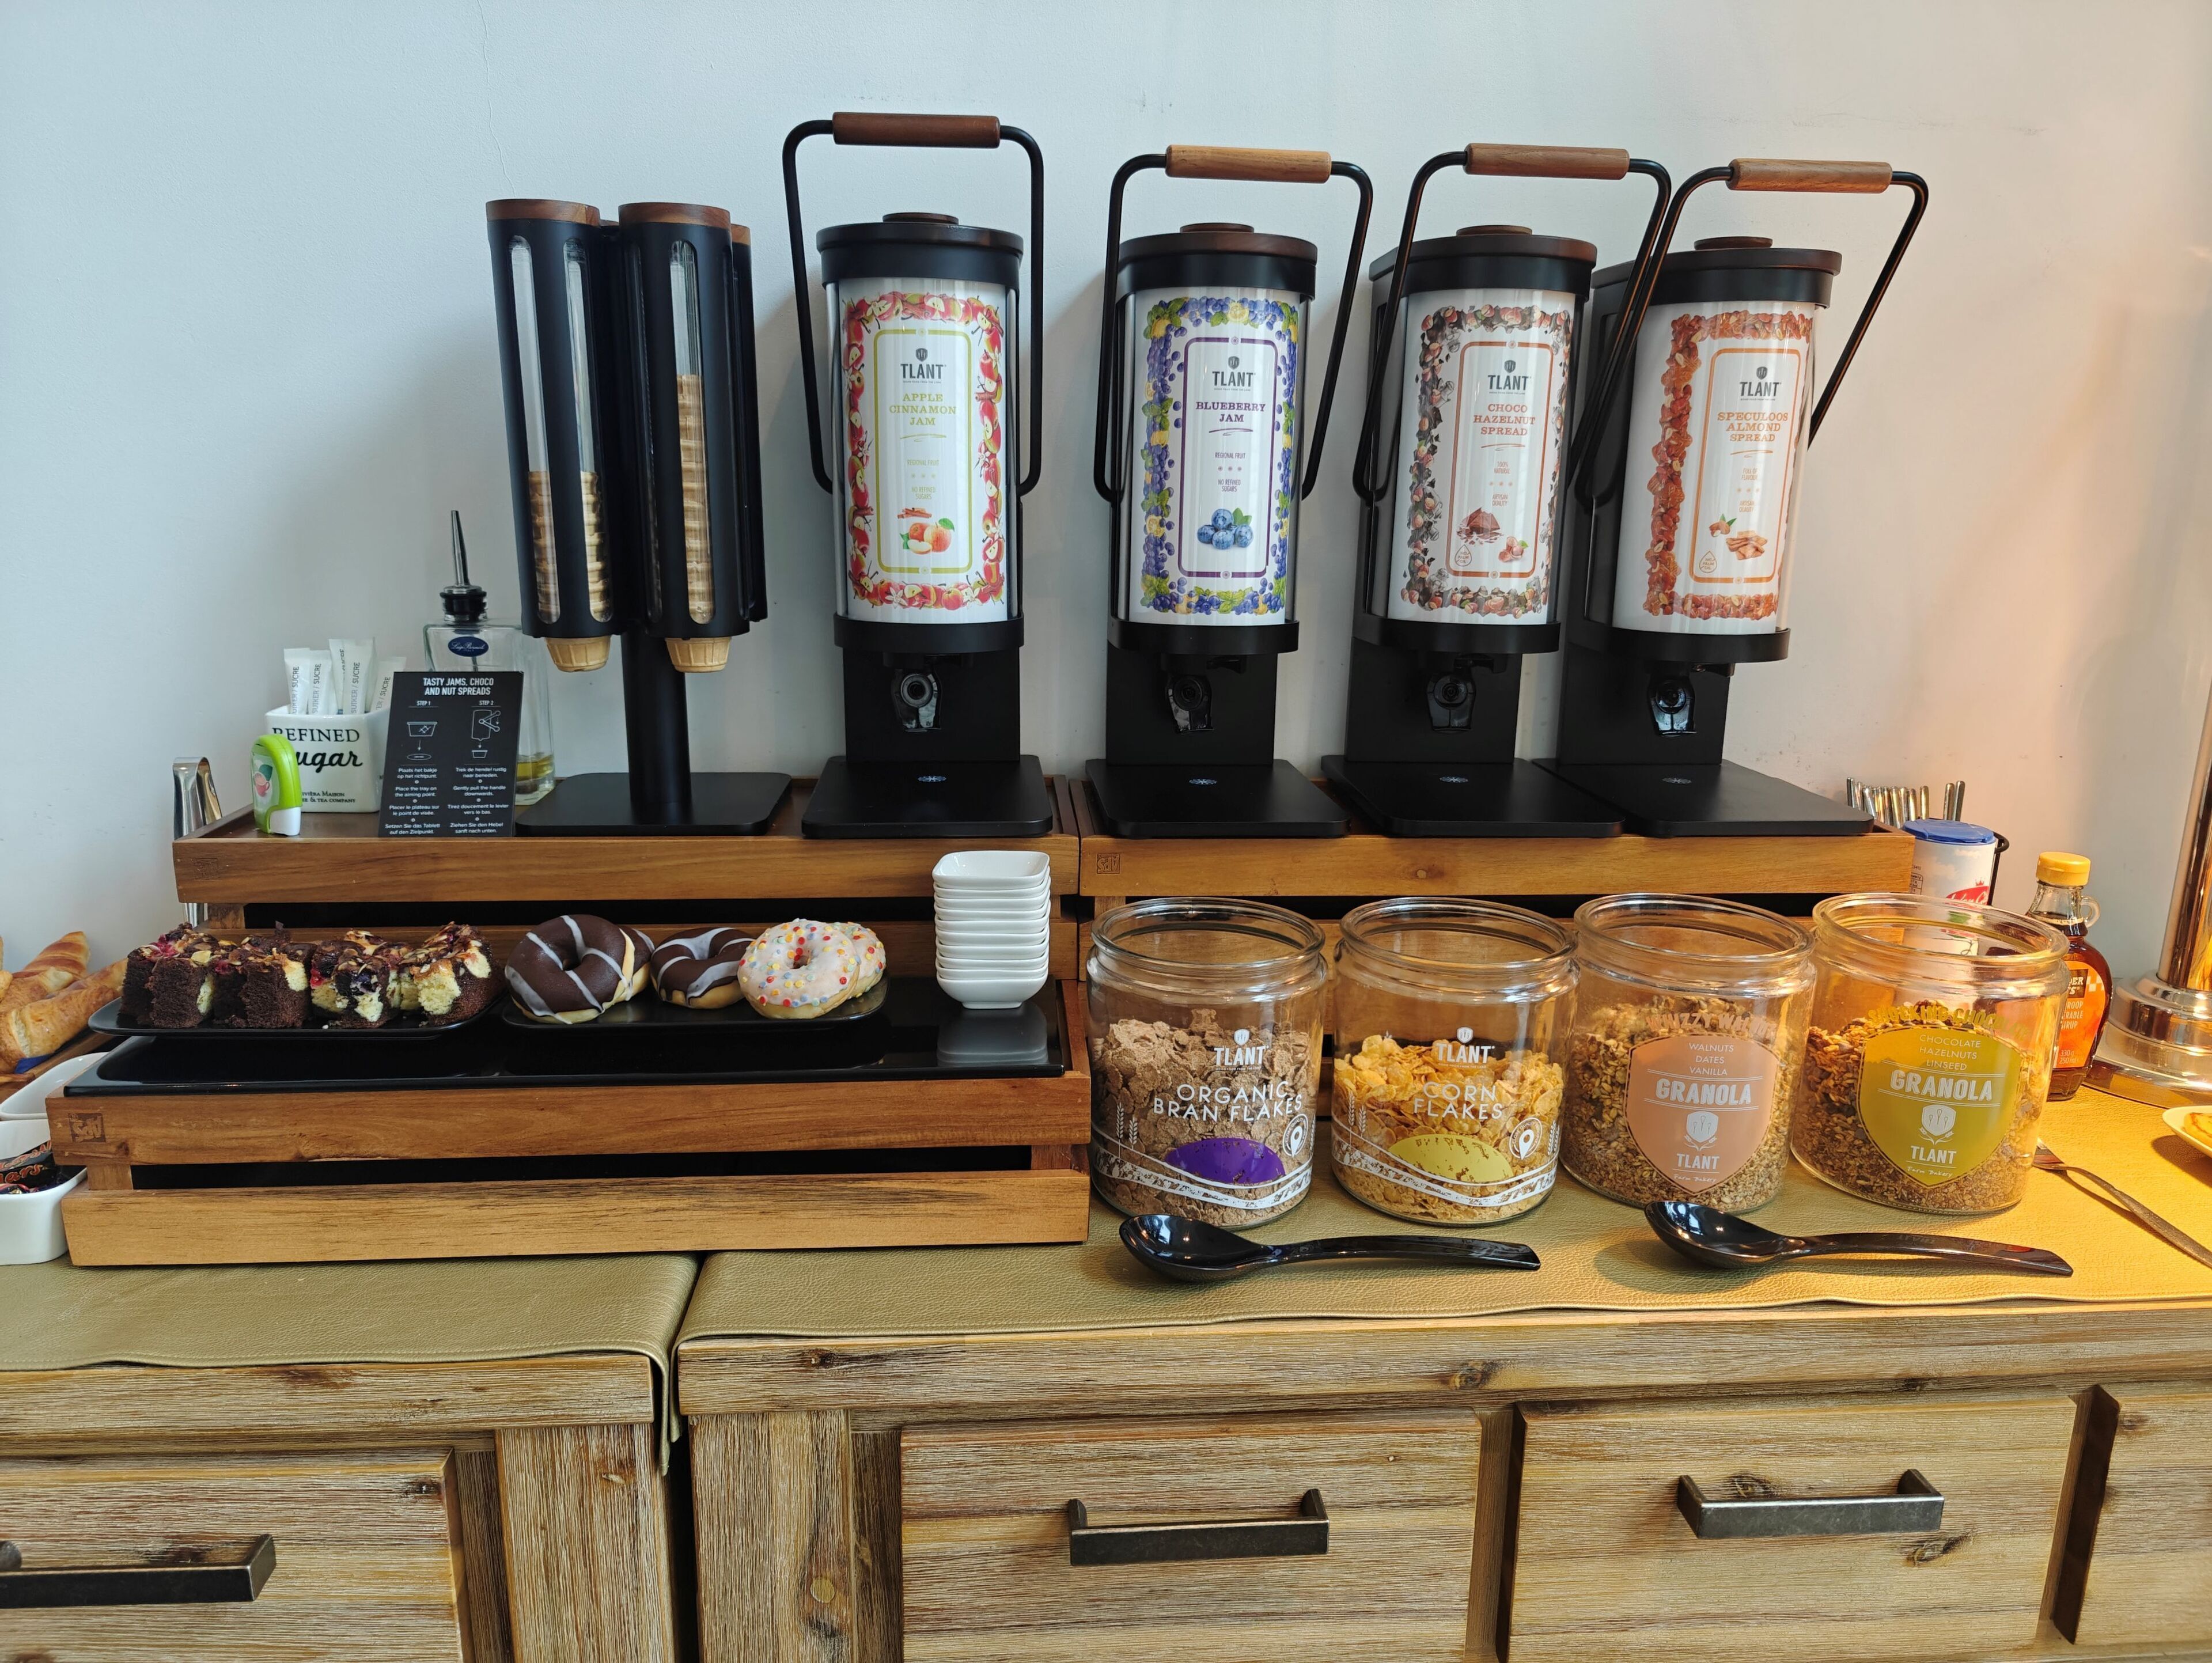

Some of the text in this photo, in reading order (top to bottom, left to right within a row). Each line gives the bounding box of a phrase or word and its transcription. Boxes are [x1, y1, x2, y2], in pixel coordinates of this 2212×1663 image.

[900, 363, 944, 379] TLANT
[1212, 371, 1253, 387] TLANT
[1487, 375, 1529, 391] TLANT
[1740, 382, 1779, 396] TLANT
[903, 393, 943, 401] APPLE
[889, 405, 956, 414] CINNAMON
[1196, 401, 1266, 411] BLUEBERRY
[1488, 404, 1528, 413] CHOCO
[910, 417, 935, 426] JAM
[1219, 414, 1244, 422] JAM
[1473, 415, 1536, 425] HAZELNUT
[1717, 412, 1789, 421] SPECULOOS
[1480, 426, 1527, 435] SPREAD
[1726, 423, 1781, 431] ALMOND
[1730, 434, 1775, 442] SPREAD
[291, 666, 300, 688] SUCRE
[313, 663, 321, 684] SUCRE
[380, 676, 391, 696] SUCRE
[423, 677, 445, 685] TASTY
[469, 677, 494, 685] CHOCO
[425, 687, 491, 695] AND NUT SPREADS
[312, 690, 320, 714] SUIKER
[296, 751, 363, 773] ugar
[1688, 1043, 1734, 1052] WALNUTS
[1919, 1035, 1982, 1048] CHOCOLATE
[1214, 1045, 1266, 1066] TLANT
[1437, 1043, 1491, 1063] TLANT
[1919, 1046, 1977, 1059] HAZELNUTS
[1695, 1055, 1725, 1064] DATES
[1926, 1059, 1967, 1070] LINSEED
[1690, 1066, 1728, 1075] VANILLA
[1423, 1081, 1496, 1101] CORN
[1655, 1078, 1751, 1105] GRANOLA
[1890, 1069, 1993, 1101] GRANOLA
[1177, 1081, 1289, 1104] ORGANIC
[1154, 1094, 1302, 1123] BRAN FLAKES
[1414, 1098, 1503, 1119] FLAKES
[1676, 1153, 1720, 1169] TLANT
[1910, 1145, 1957, 1164] TLANT
[0, 1164, 43, 1183] ars
[1928, 1170, 1953, 1178] Bakery
